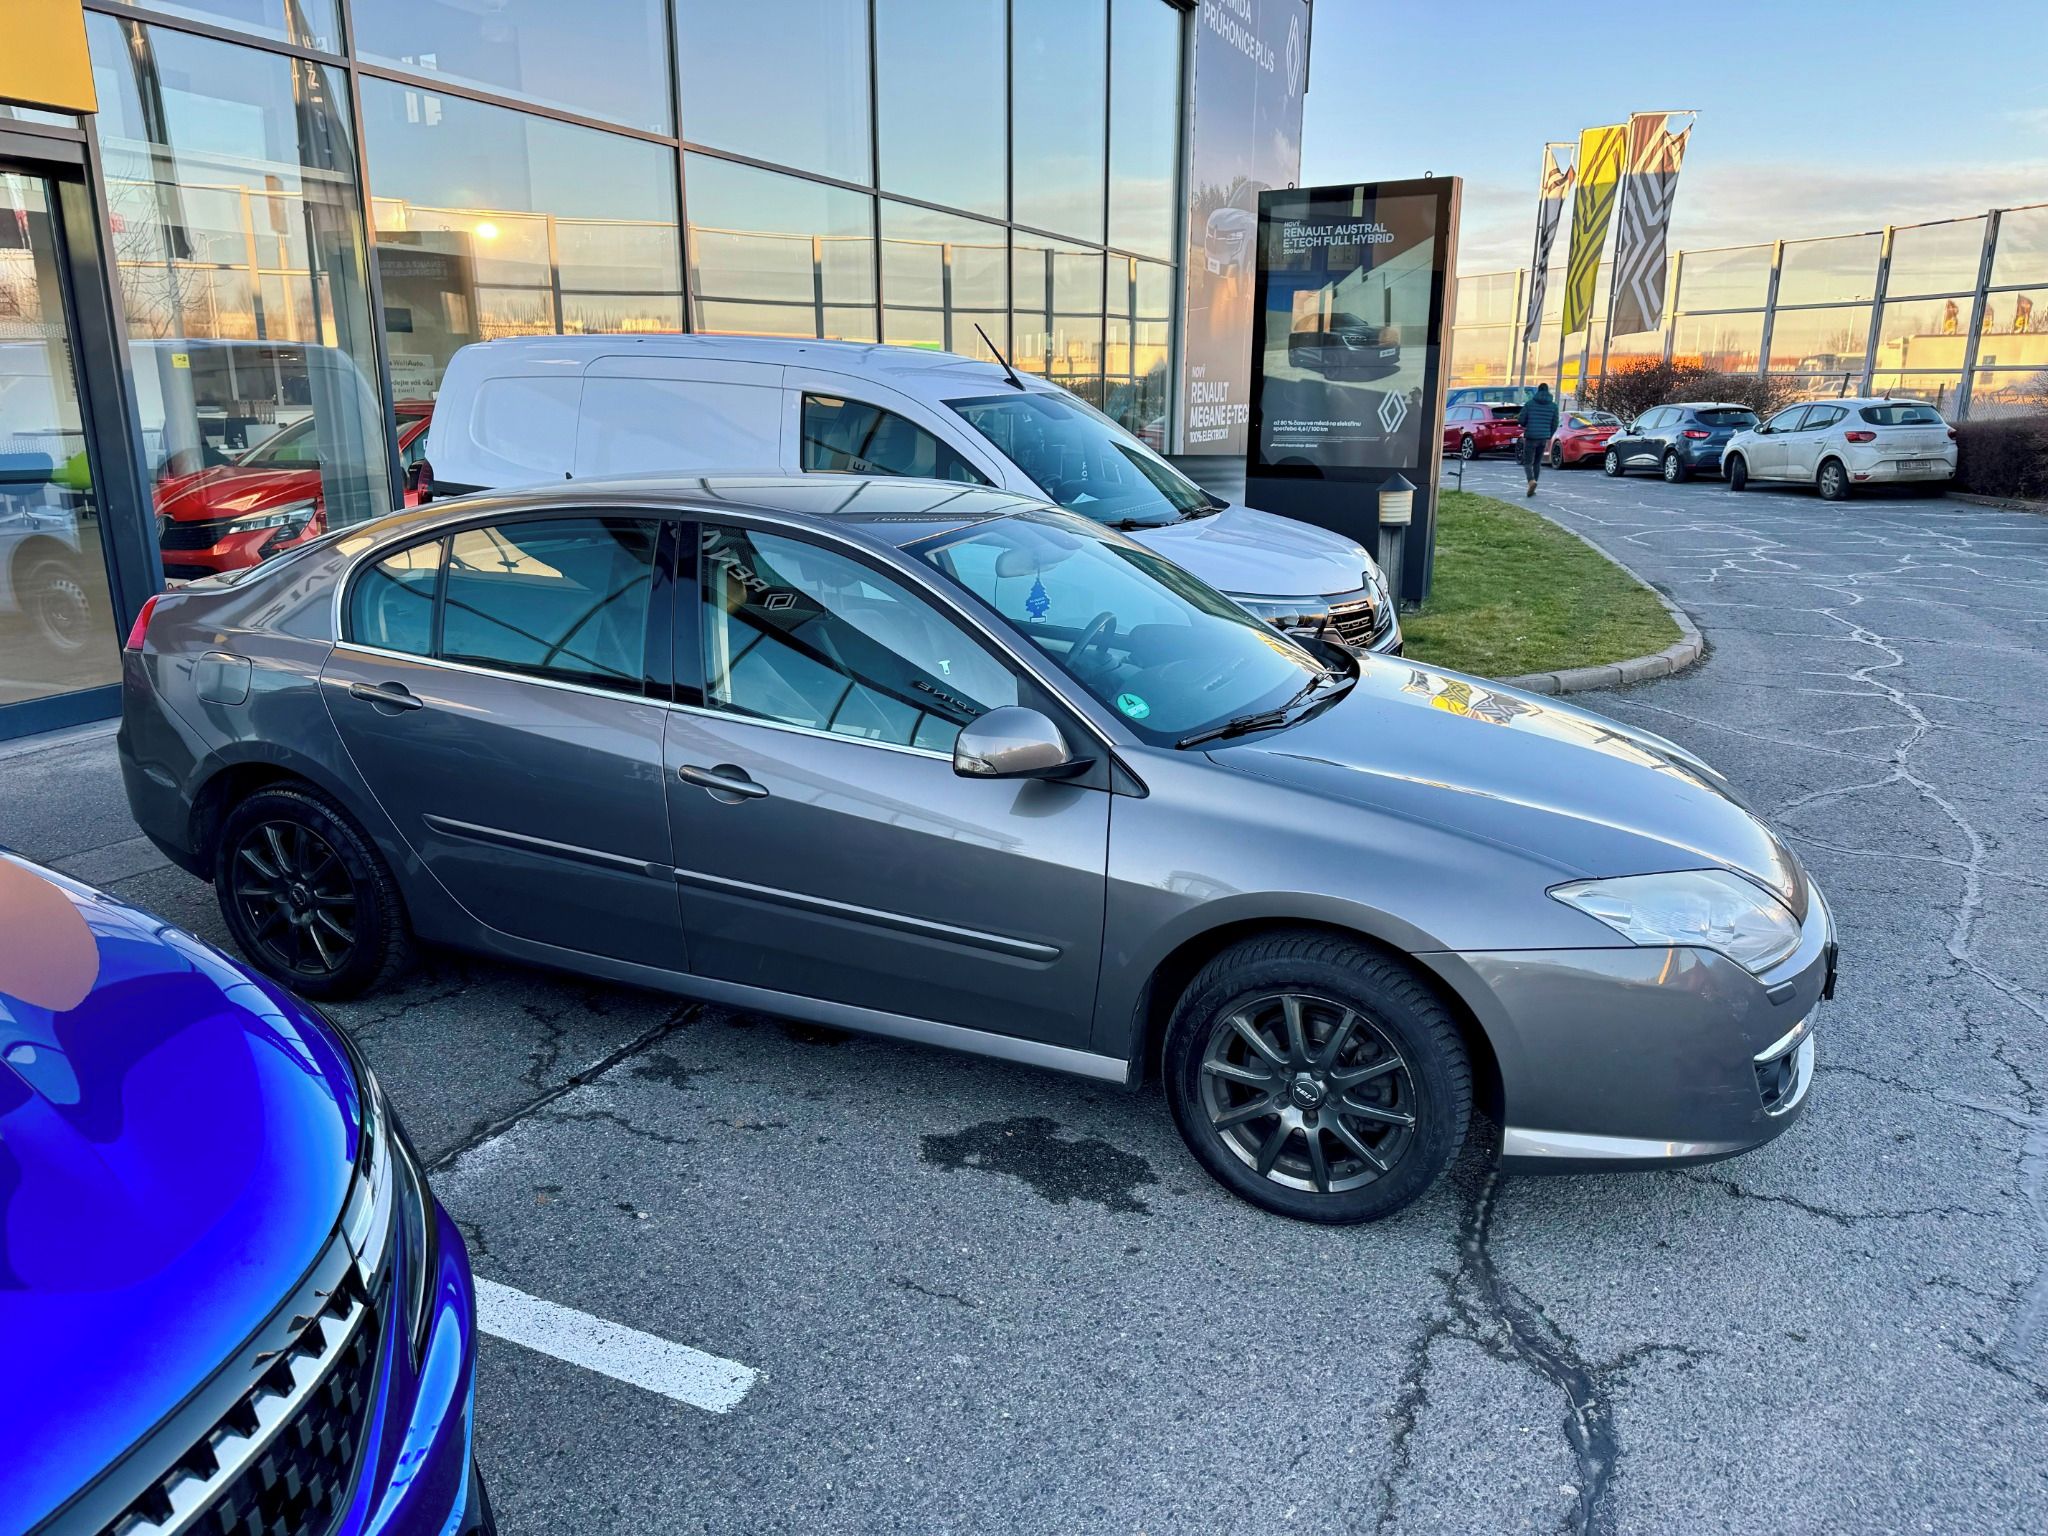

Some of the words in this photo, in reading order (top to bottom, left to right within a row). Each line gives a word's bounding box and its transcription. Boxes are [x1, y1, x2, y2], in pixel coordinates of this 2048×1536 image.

[1255, 40, 1274, 73] PLUS
[1283, 225, 1334, 238] RENAULT
[1334, 222, 1388, 236] AUSTRAL
[1283, 237, 1322, 249] E-TECH
[1323, 235, 1351, 247] FULL
[1352, 232, 1395, 245] HYBRID
[1191, 381, 1230, 404] RENAULT
[1190, 404, 1226, 429] MEGANE
[1226, 403, 1249, 425] E-TEC
